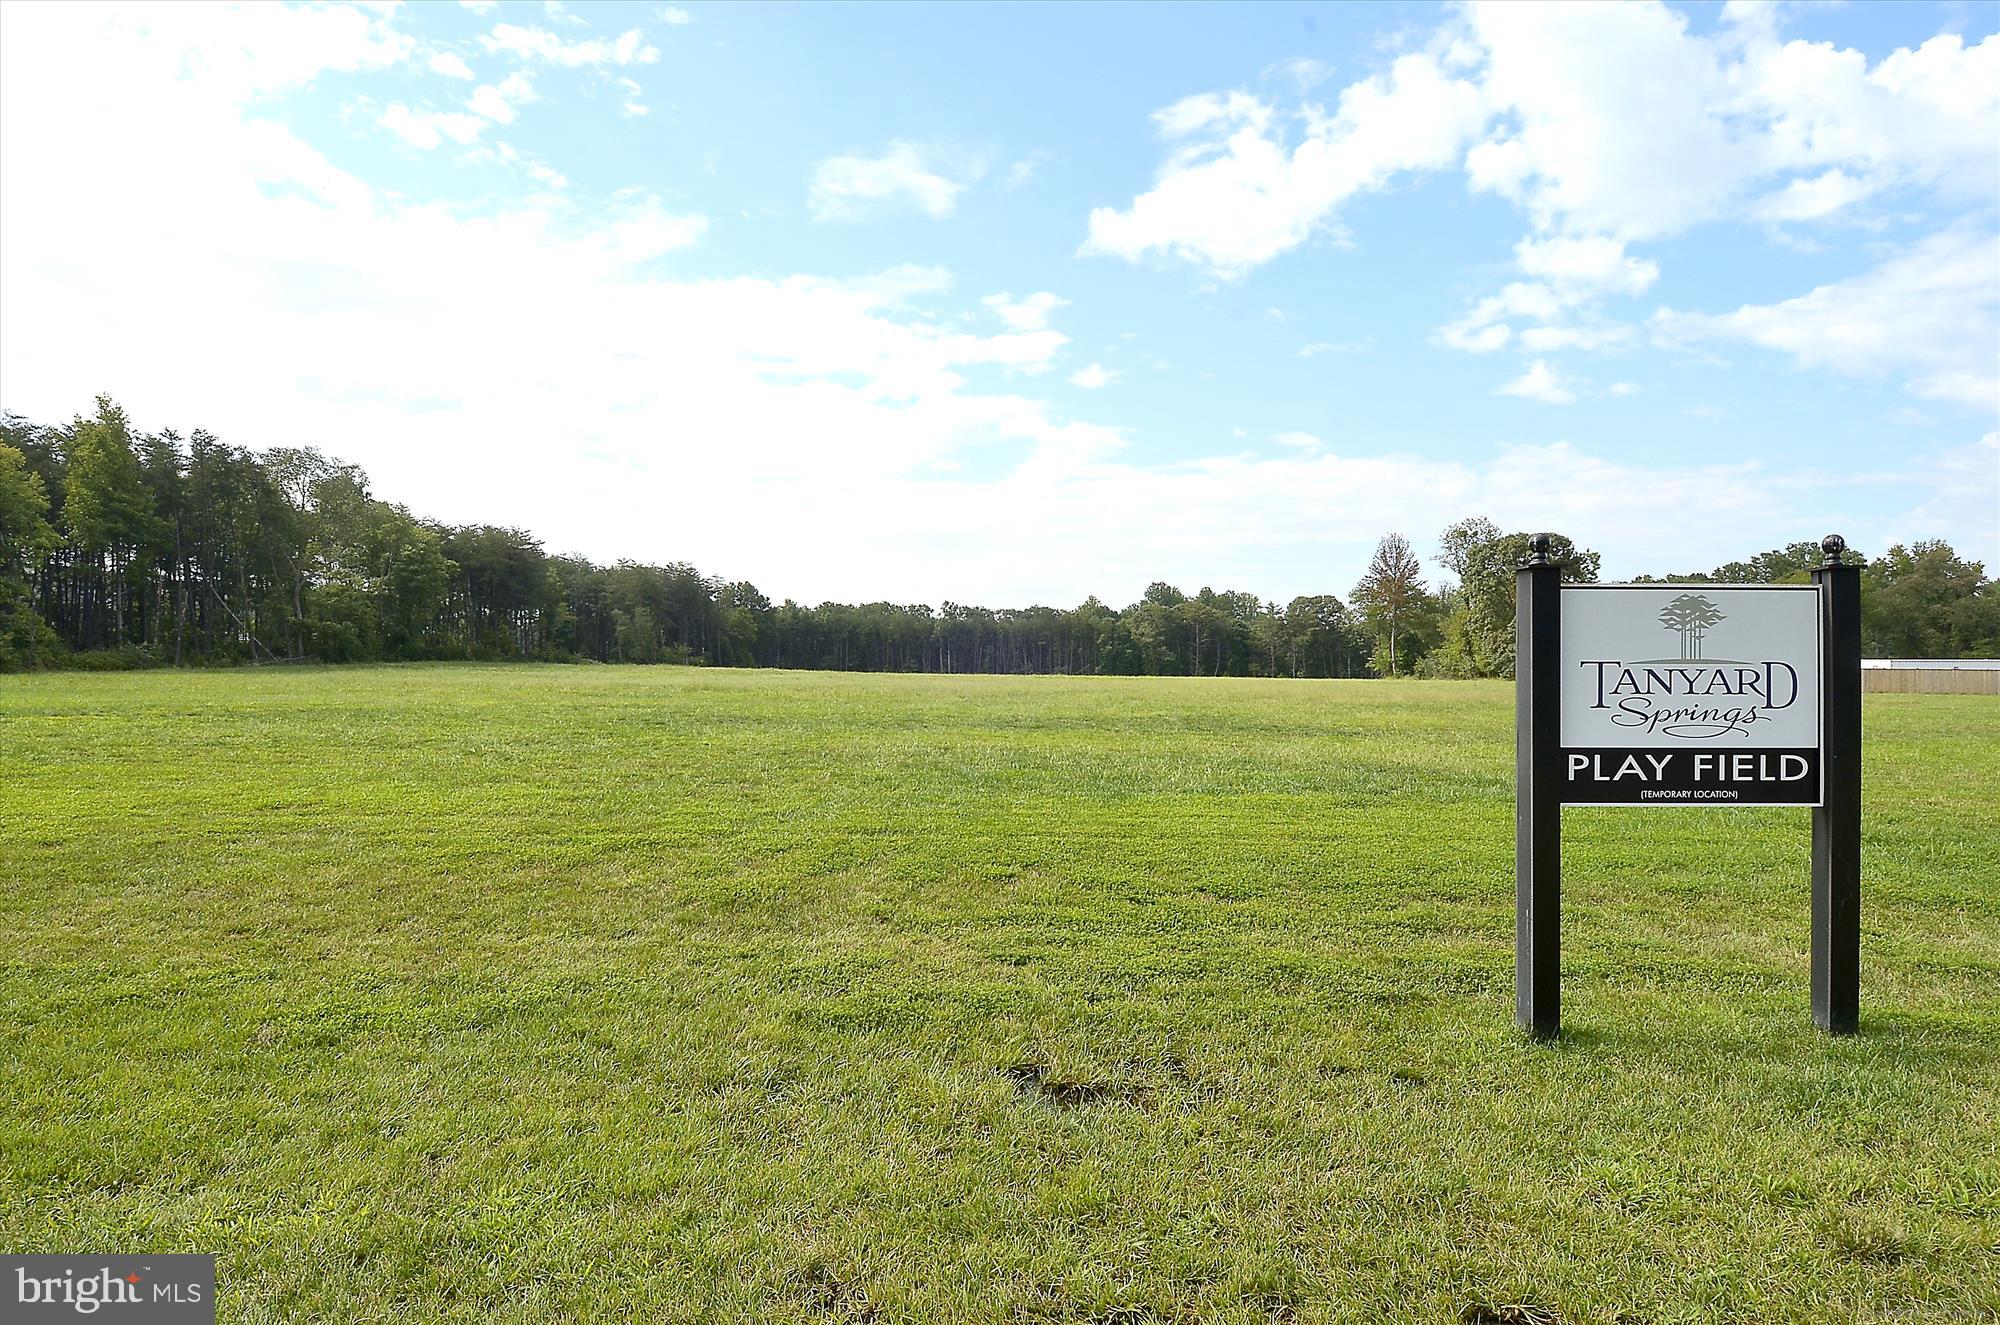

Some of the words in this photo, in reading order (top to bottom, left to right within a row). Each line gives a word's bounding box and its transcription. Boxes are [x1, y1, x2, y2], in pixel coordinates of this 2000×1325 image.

[1580, 661, 1798, 709] TANYARD
[1611, 697, 1772, 739] Springs
[1568, 754, 1673, 781] PLAY
[1694, 754, 1809, 781] FIELD
[1640, 790, 1692, 800] (TEMPORARY
[1694, 790, 1738, 800] LOCATION)
